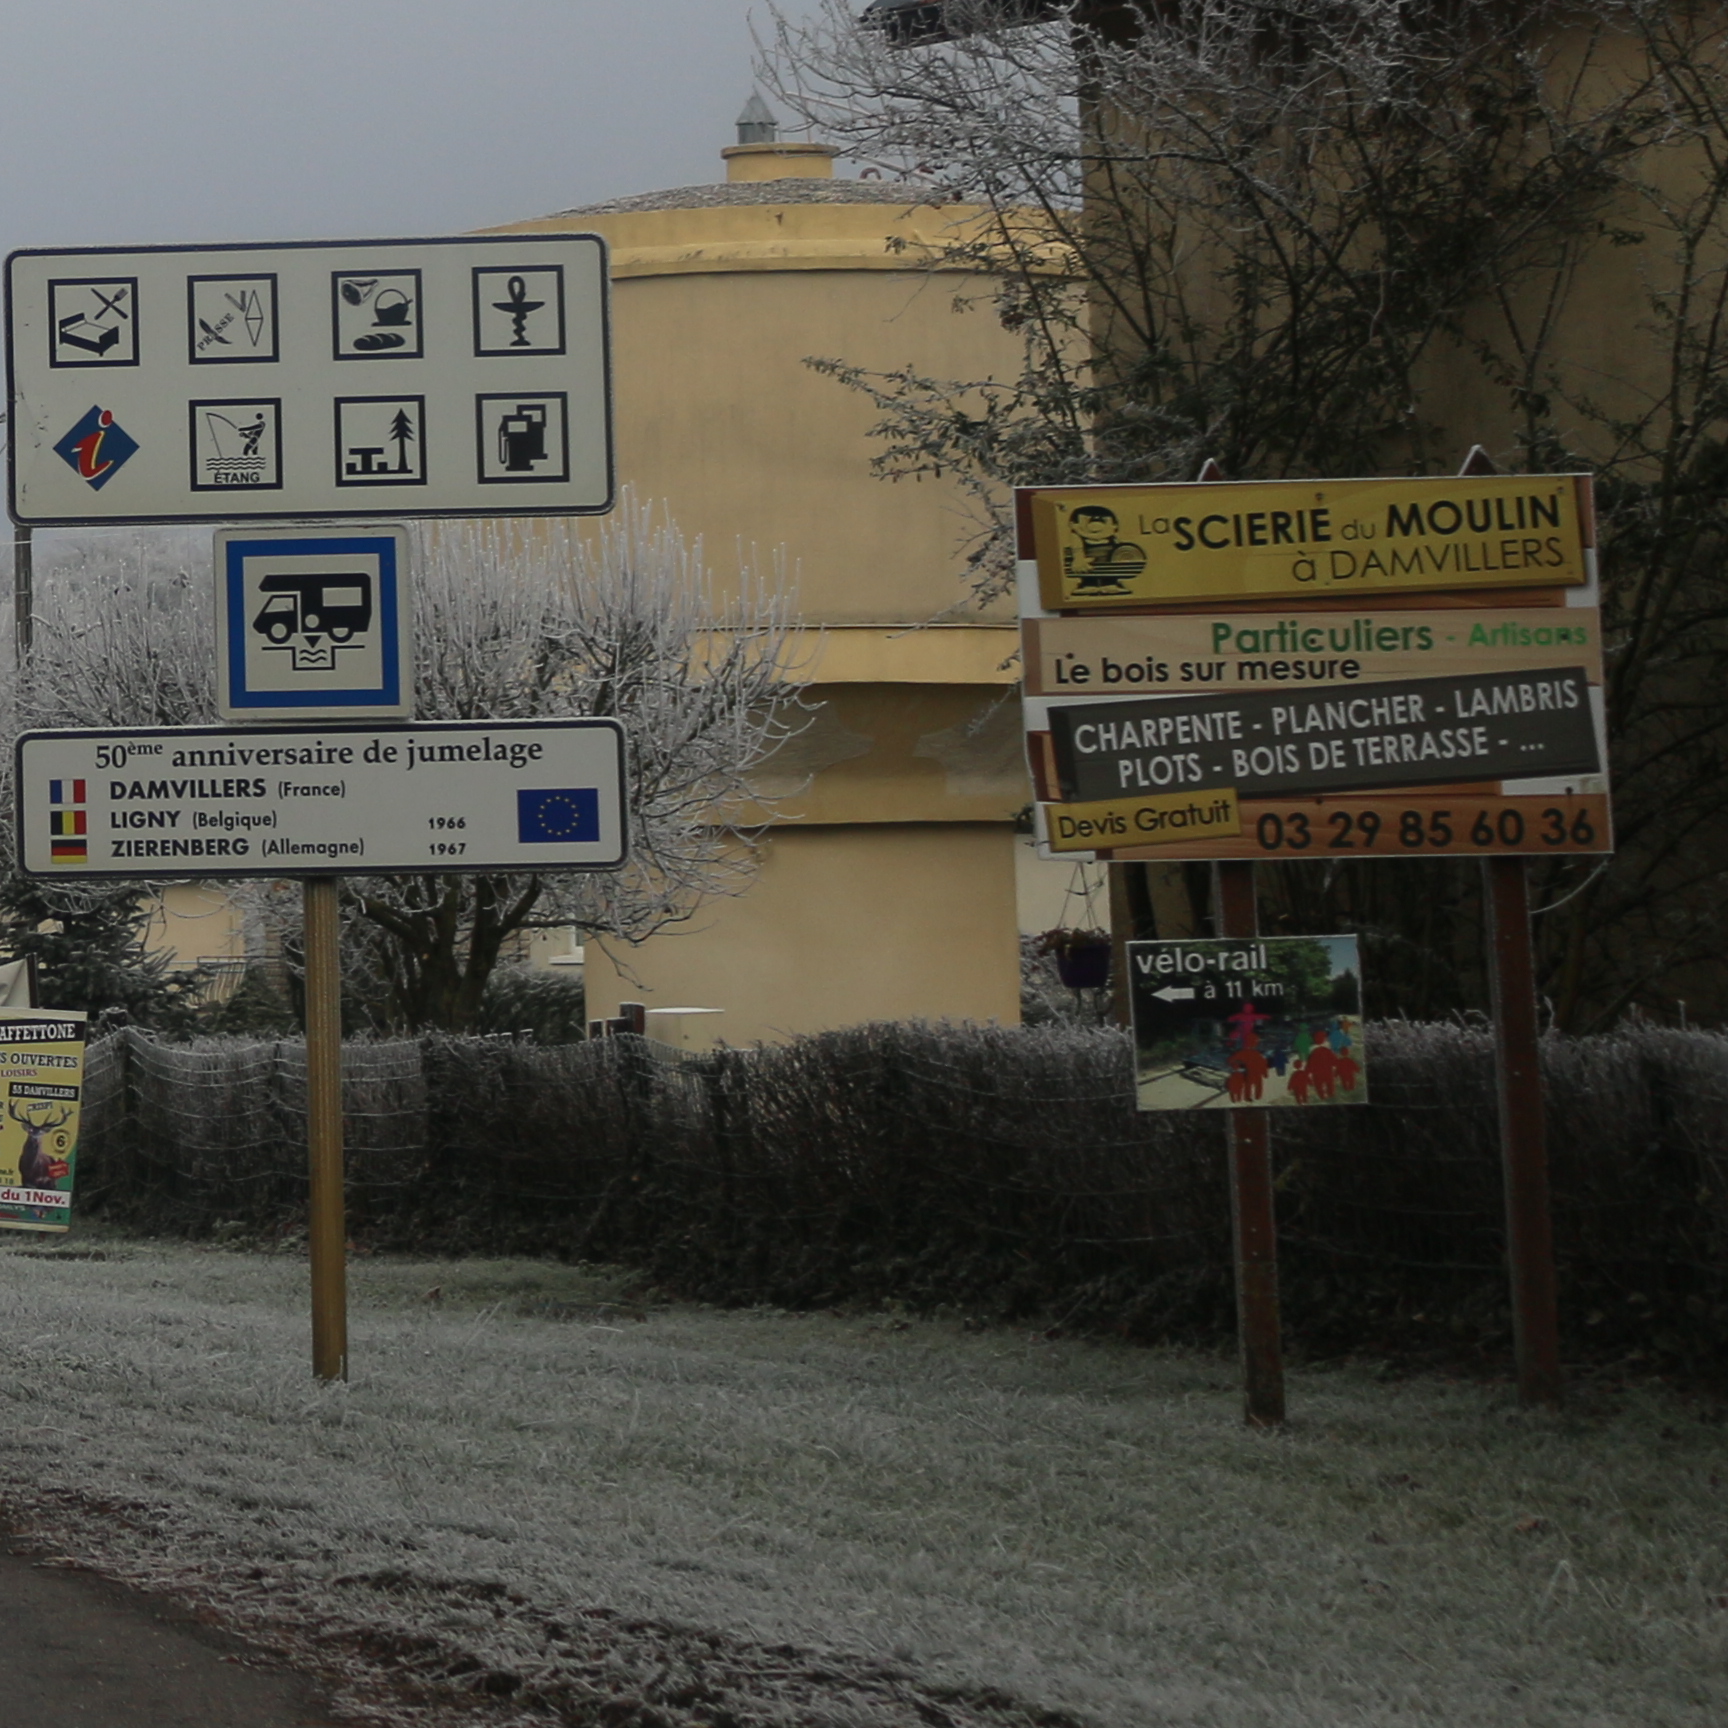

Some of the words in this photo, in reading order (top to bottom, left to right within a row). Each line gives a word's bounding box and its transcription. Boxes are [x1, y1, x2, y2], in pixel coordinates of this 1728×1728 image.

[214, 469, 260, 484] ÉTANG
[1139, 514, 1169, 535] La
[1173, 508, 1332, 551] SCIERIE
[1341, 519, 1375, 541] du
[1387, 494, 1560, 538] MOULIN
[1293, 550, 1316, 582] à
[1330, 536, 1563, 580] DAMVILLERS
[1211, 619, 1434, 654] Particuliers
[1468, 623, 1588, 647] Artisans
[1056, 658, 1090, 684] Le
[1102, 656, 1169, 683] bois
[1180, 660, 1226, 682] sur
[1237, 659, 1360, 681] mesure
[1074, 711, 1243, 754] CHARPENTE
[1271, 694, 1426, 736] PLANCHER
[1454, 679, 1580, 718] LAMBRIS
[95, 741, 163, 768] 50ème
[172, 740, 353, 767] anniversaire
[363, 739, 398, 763] de
[406, 736, 543, 770] jumelage
[1118, 753, 1203, 788] PLOTS
[1232, 744, 1300, 778] BOIS
[1309, 740, 1346, 771] DE
[1352, 727, 1489, 766] TERRASSE
[110, 778, 266, 800] DAMVILLERS
[278, 780, 345, 799] (France)
[111, 810, 181, 829] LIGNY
[193, 810, 277, 830] (Belgique)
[428, 817, 466, 829] 1966
[1058, 812, 1127, 839] Devis
[1134, 800, 1231, 832] Gratuit
[1257, 812, 1312, 850] 03
[1328, 810, 1381, 849] 29
[1399, 810, 1453, 848] 85
[1470, 809, 1524, 846] 60
[1540, 808, 1595, 846] 36
[111, 837, 250, 857] ZIERENBERG
[261, 838, 364, 858] (Allemagne)
[429, 843, 466, 855] 1967
[1135, 944, 1268, 974] vélo-rail
[1203, 982, 1216, 999] à
[1225, 981, 1242, 998] 11
[1252, 980, 1284, 997] km
[10, 1053, 78, 1068] OUVERTES
[0, 1068, 38, 1077] LOISIRS
[23, 1085, 76, 1098] DAMVILLERS
[56, 1135, 65, 1147] 6
[1, 1188, 20, 1201] du
